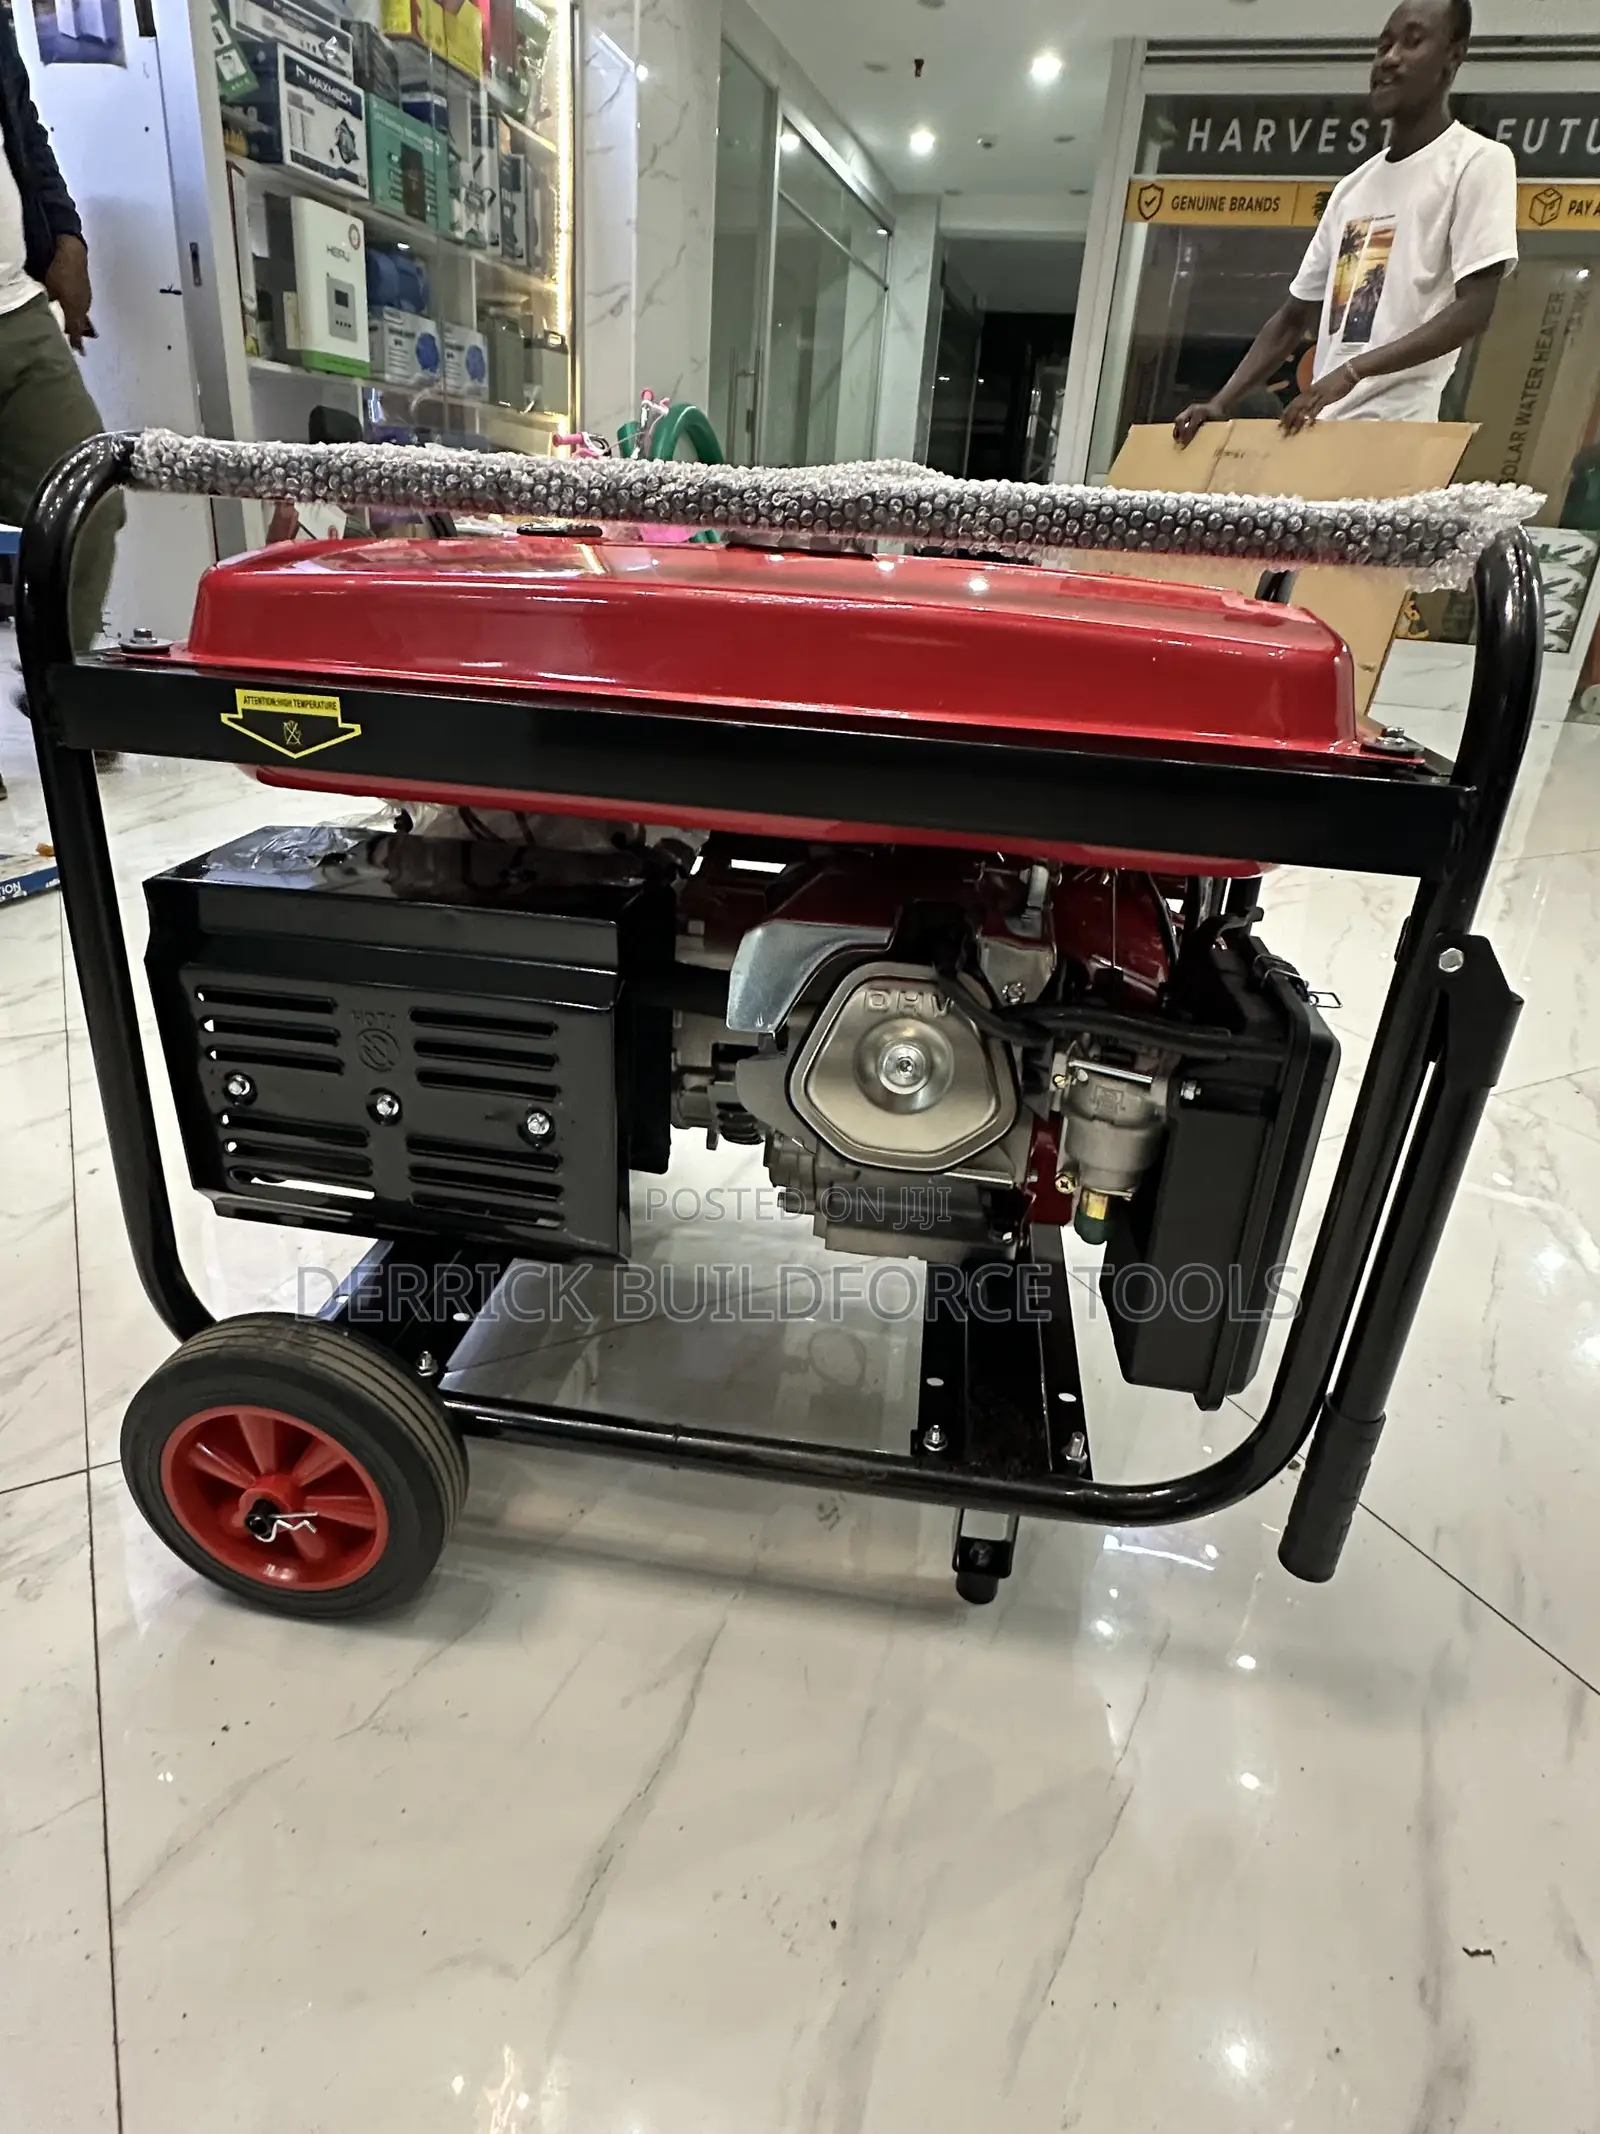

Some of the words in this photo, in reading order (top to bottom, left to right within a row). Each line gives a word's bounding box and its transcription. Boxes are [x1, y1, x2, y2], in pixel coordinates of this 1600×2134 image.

[1171, 195, 1225, 212] GENUINE
[1229, 196, 1281, 213] BRANDS
[1567, 199, 1592, 216] PAY
[1515, 366, 1546, 427] WATER
[1532, 291, 1566, 363] HEATER
[293, 698, 338, 711] TEMPERATURE
[864, 985, 953, 1018] OHV
